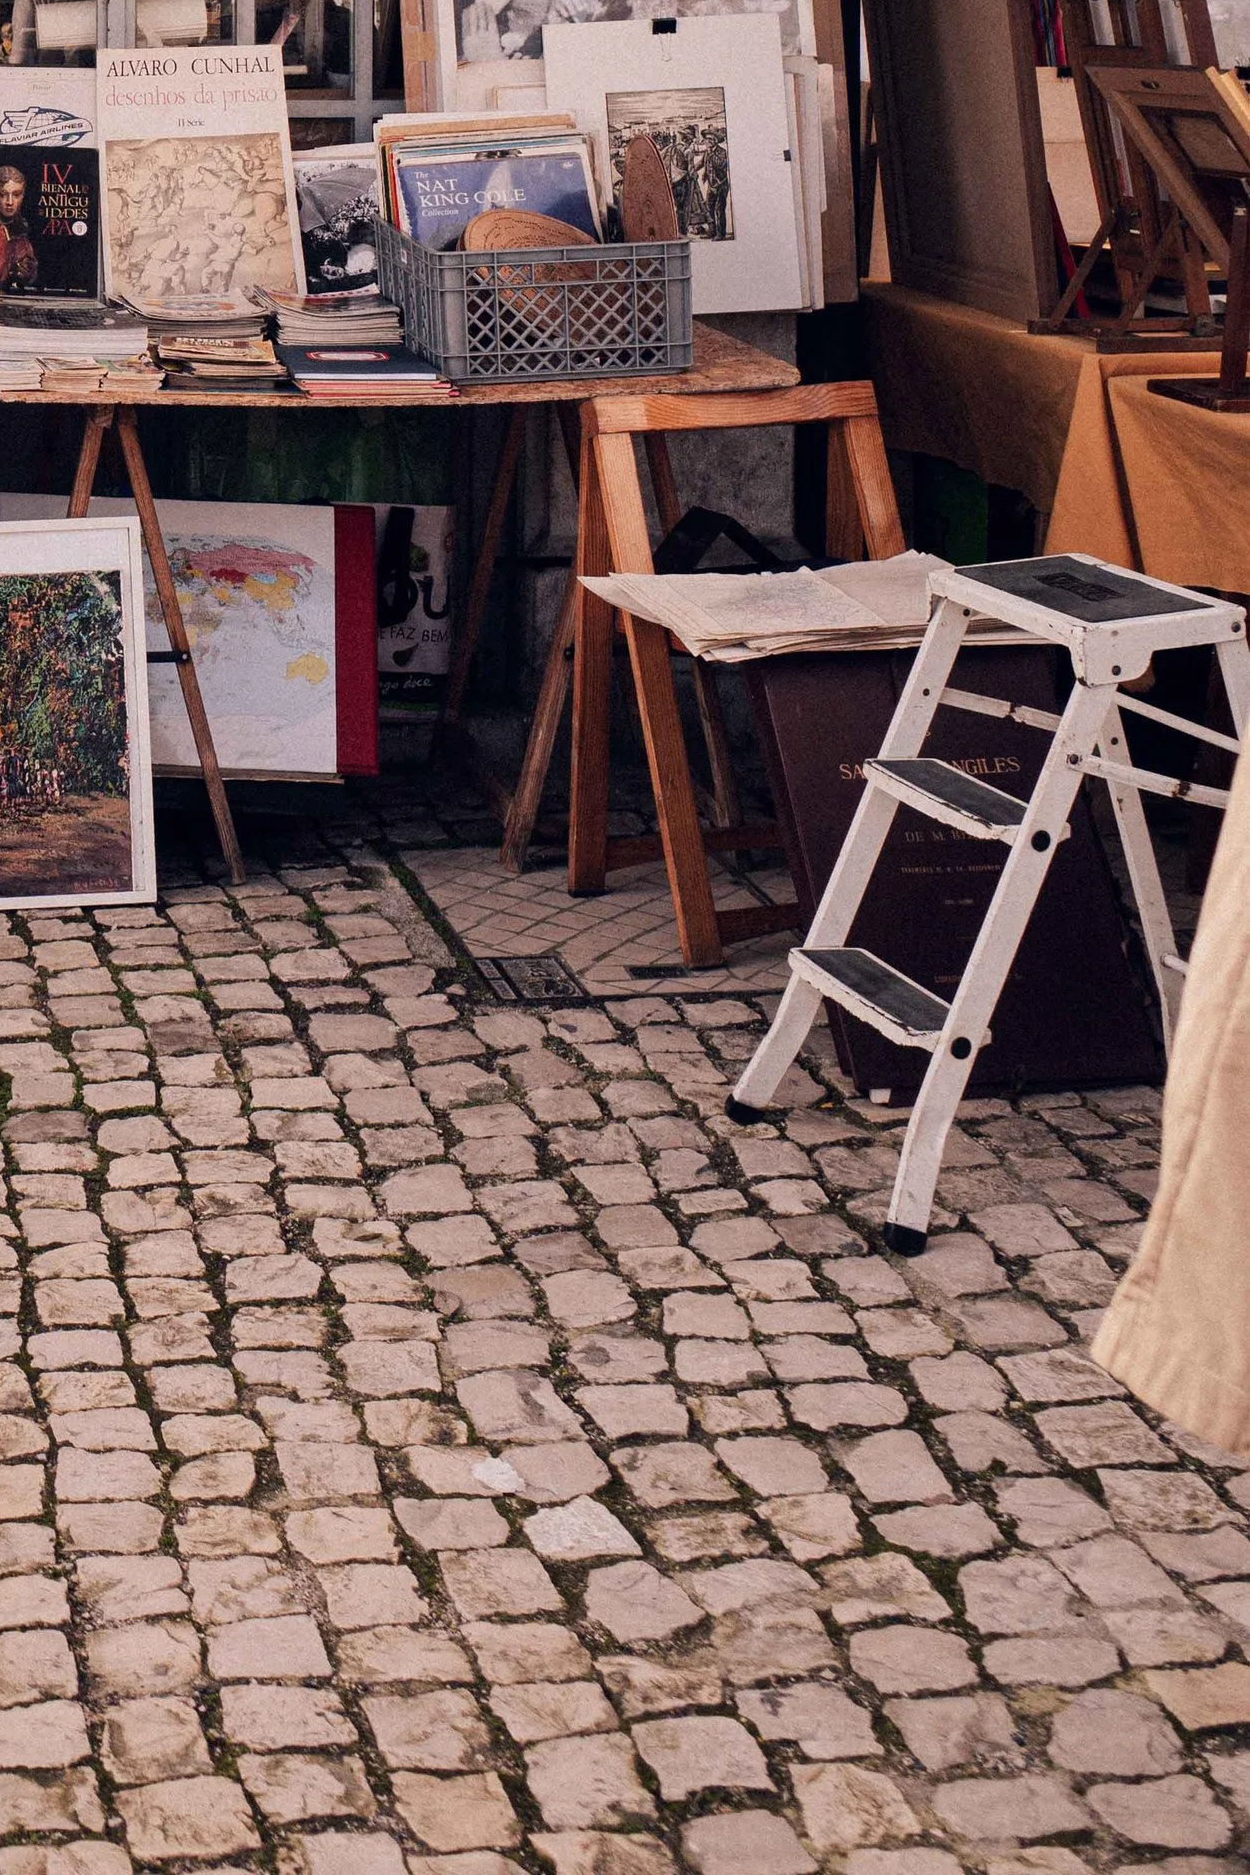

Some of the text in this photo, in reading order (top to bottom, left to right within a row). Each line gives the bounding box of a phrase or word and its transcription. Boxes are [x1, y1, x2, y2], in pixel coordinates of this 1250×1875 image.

[191, 56, 275, 75] CUNHAL
[105, 85, 186, 107] desenhos
[194, 83, 215, 105] da
[40, 122, 85, 136] AIRLINES
[42, 163, 74, 185] IV
[413, 171, 429, 179] The
[41, 183, 81, 194] BIENAL
[416, 178, 458, 194] NAT
[420, 188, 527, 208] KING COLE
[421, 209, 459, 217] Collection
[390, 626, 416, 640] FAZ
[951, 756, 1021, 775] NGILES
